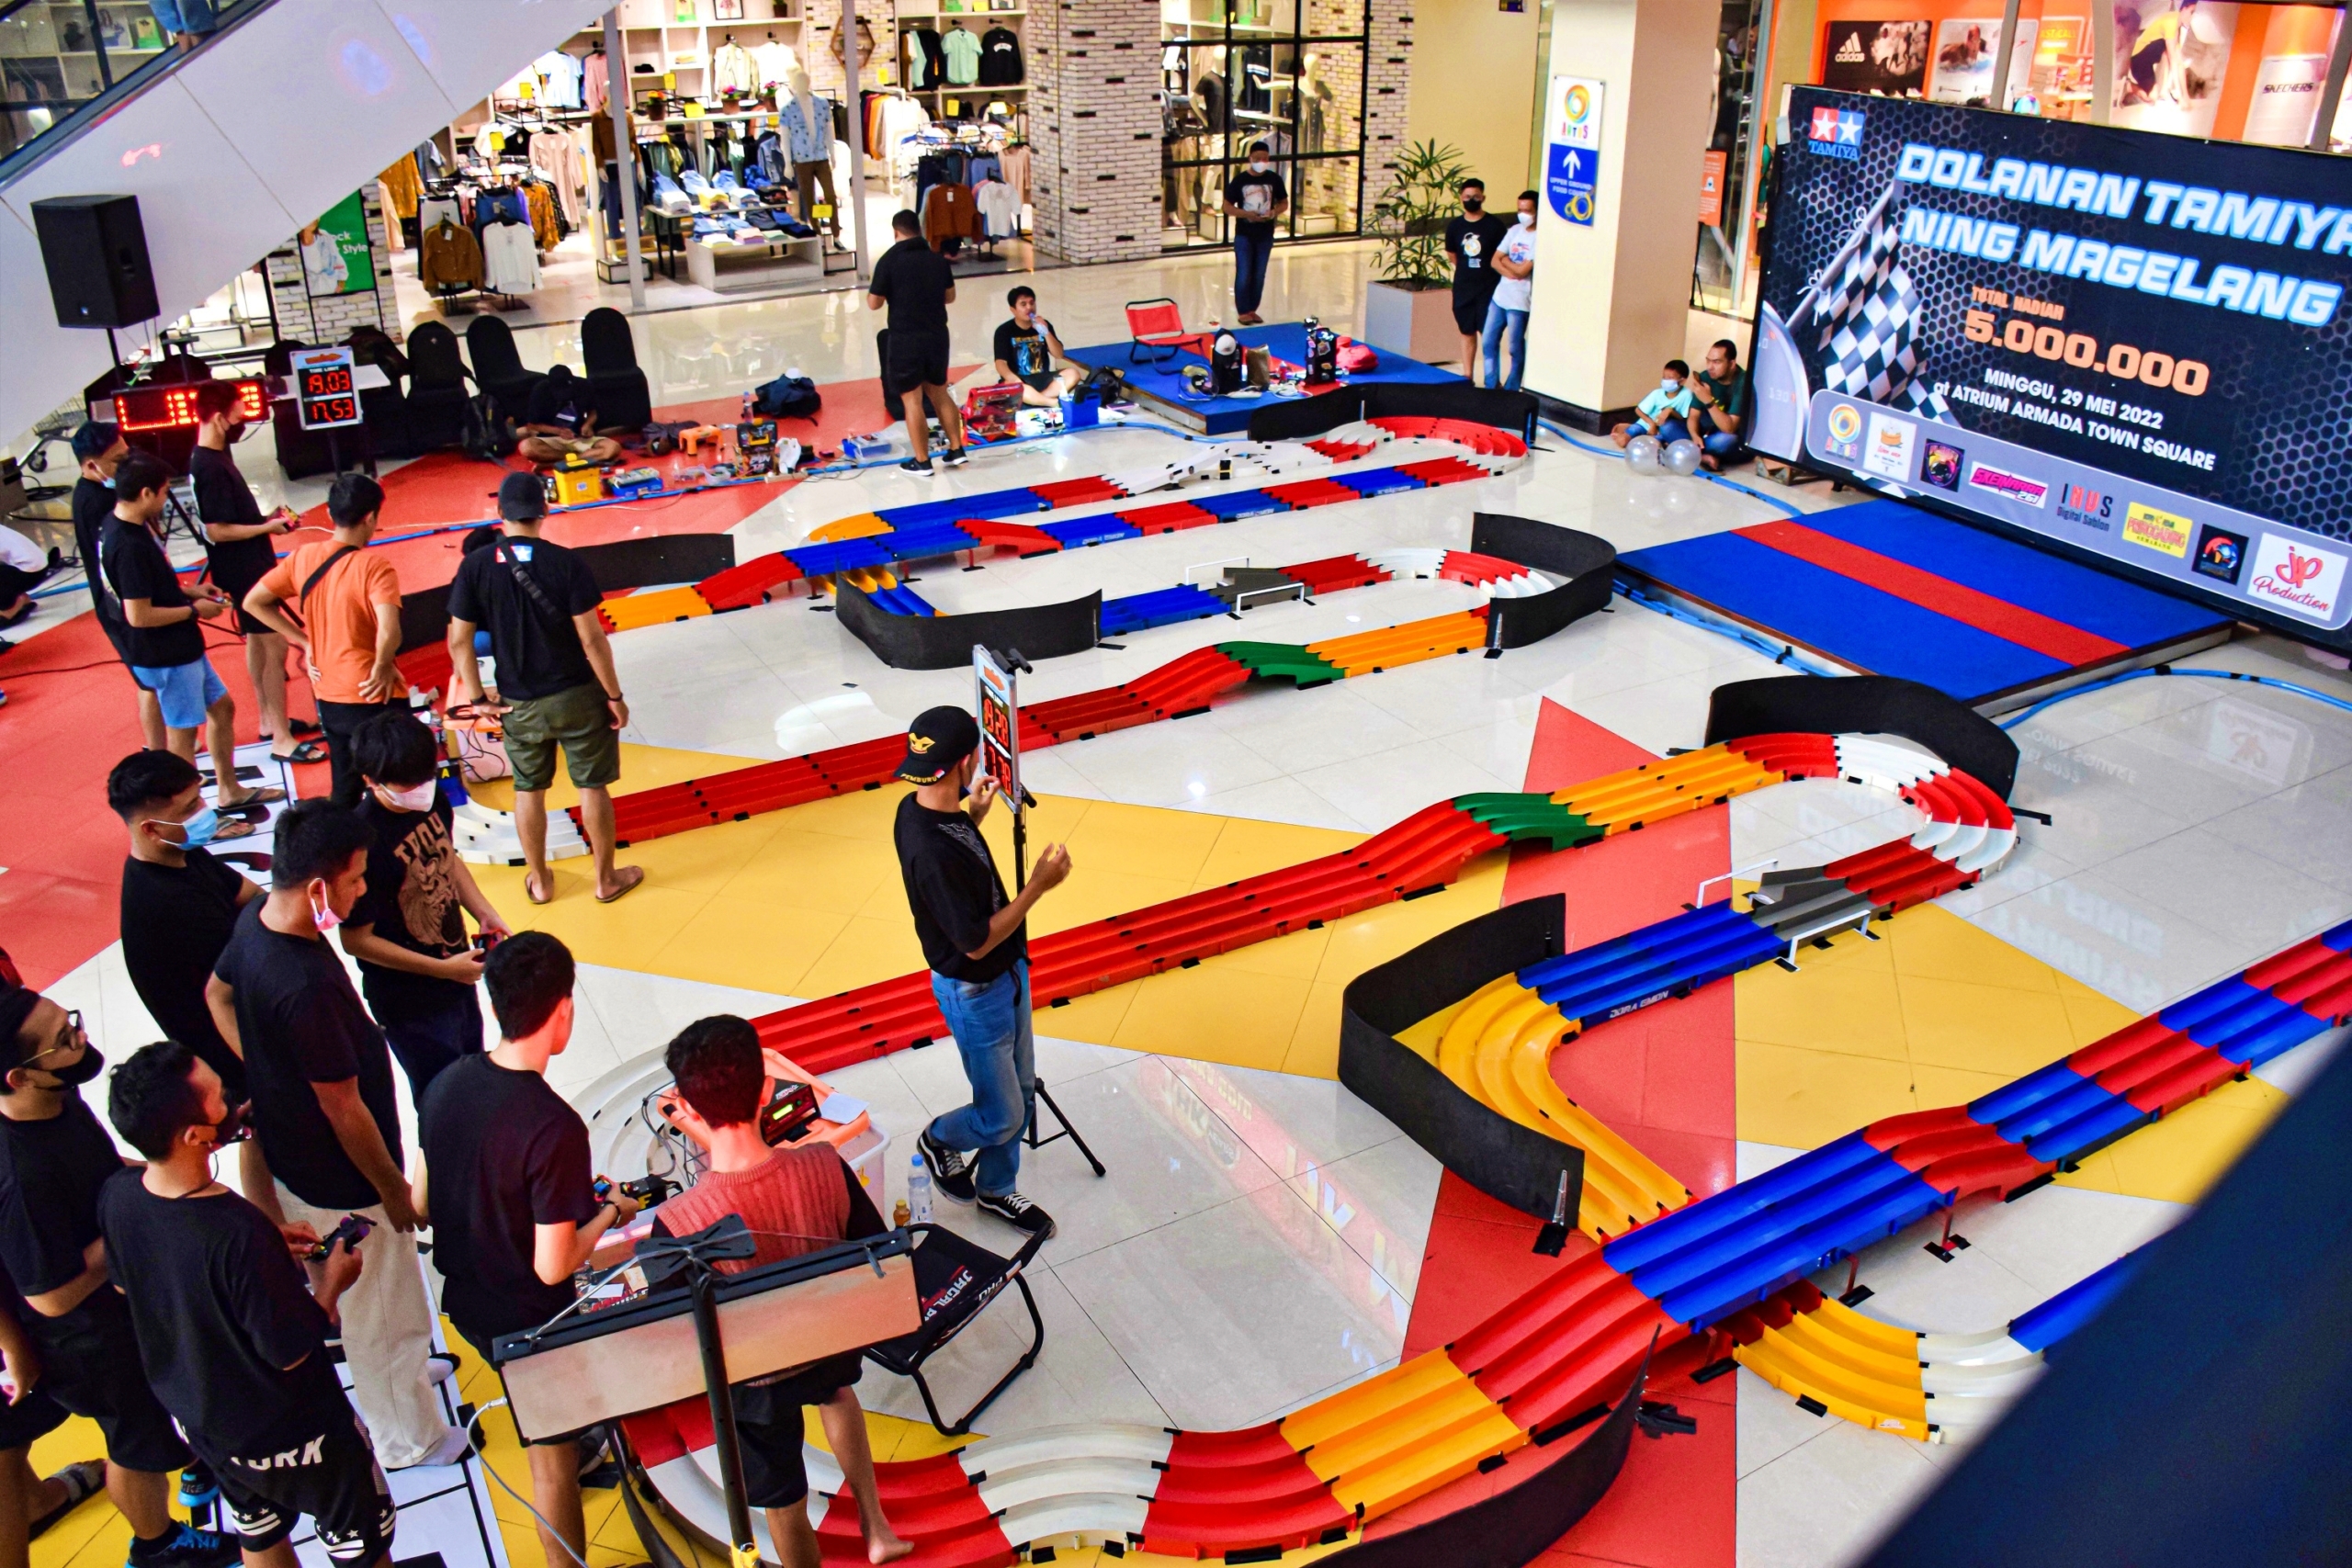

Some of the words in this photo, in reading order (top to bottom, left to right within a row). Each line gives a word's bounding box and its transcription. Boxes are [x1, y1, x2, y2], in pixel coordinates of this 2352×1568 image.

[1835, 52, 1865, 62] adidas
[2262, 82, 2314, 94] SKECHERS
[1808, 140, 1859, 161] TAMIYA
[1895, 143, 2142, 219] DOLANAN
[343, 243, 368, 254] Style
[1899, 207, 2020, 262] NING
[2020, 228, 2343, 327] MAGELANG
[1972, 286, 2008, 309] TOTAL
[2013, 295, 2065, 321] HADIAH
[1963, 308, 2210, 396] 5.000.000
[1984, 367, 2057, 404] MINGGU,
[2060, 389, 2083, 407] 29
[2085, 394, 2117, 417] MEI
[2119, 404, 2164, 429] 2022
[1933, 381, 1951, 396] at
[1951, 384, 2010, 413] ATRIUM
[2011, 400, 2084, 434] ARMADA
[2087, 421, 2140, 450] TOWN
[2142, 436, 2216, 471] SQUARE
[2057, 506, 2082, 522] Digital
[2083, 514, 2110, 532] Sablon
[2253, 575, 2330, 612] Production
[900, 773, 937, 784] PEMBURU
[1609, 1003, 1637, 1019] DORA
[933, 1269, 972, 1306] JAGAL
